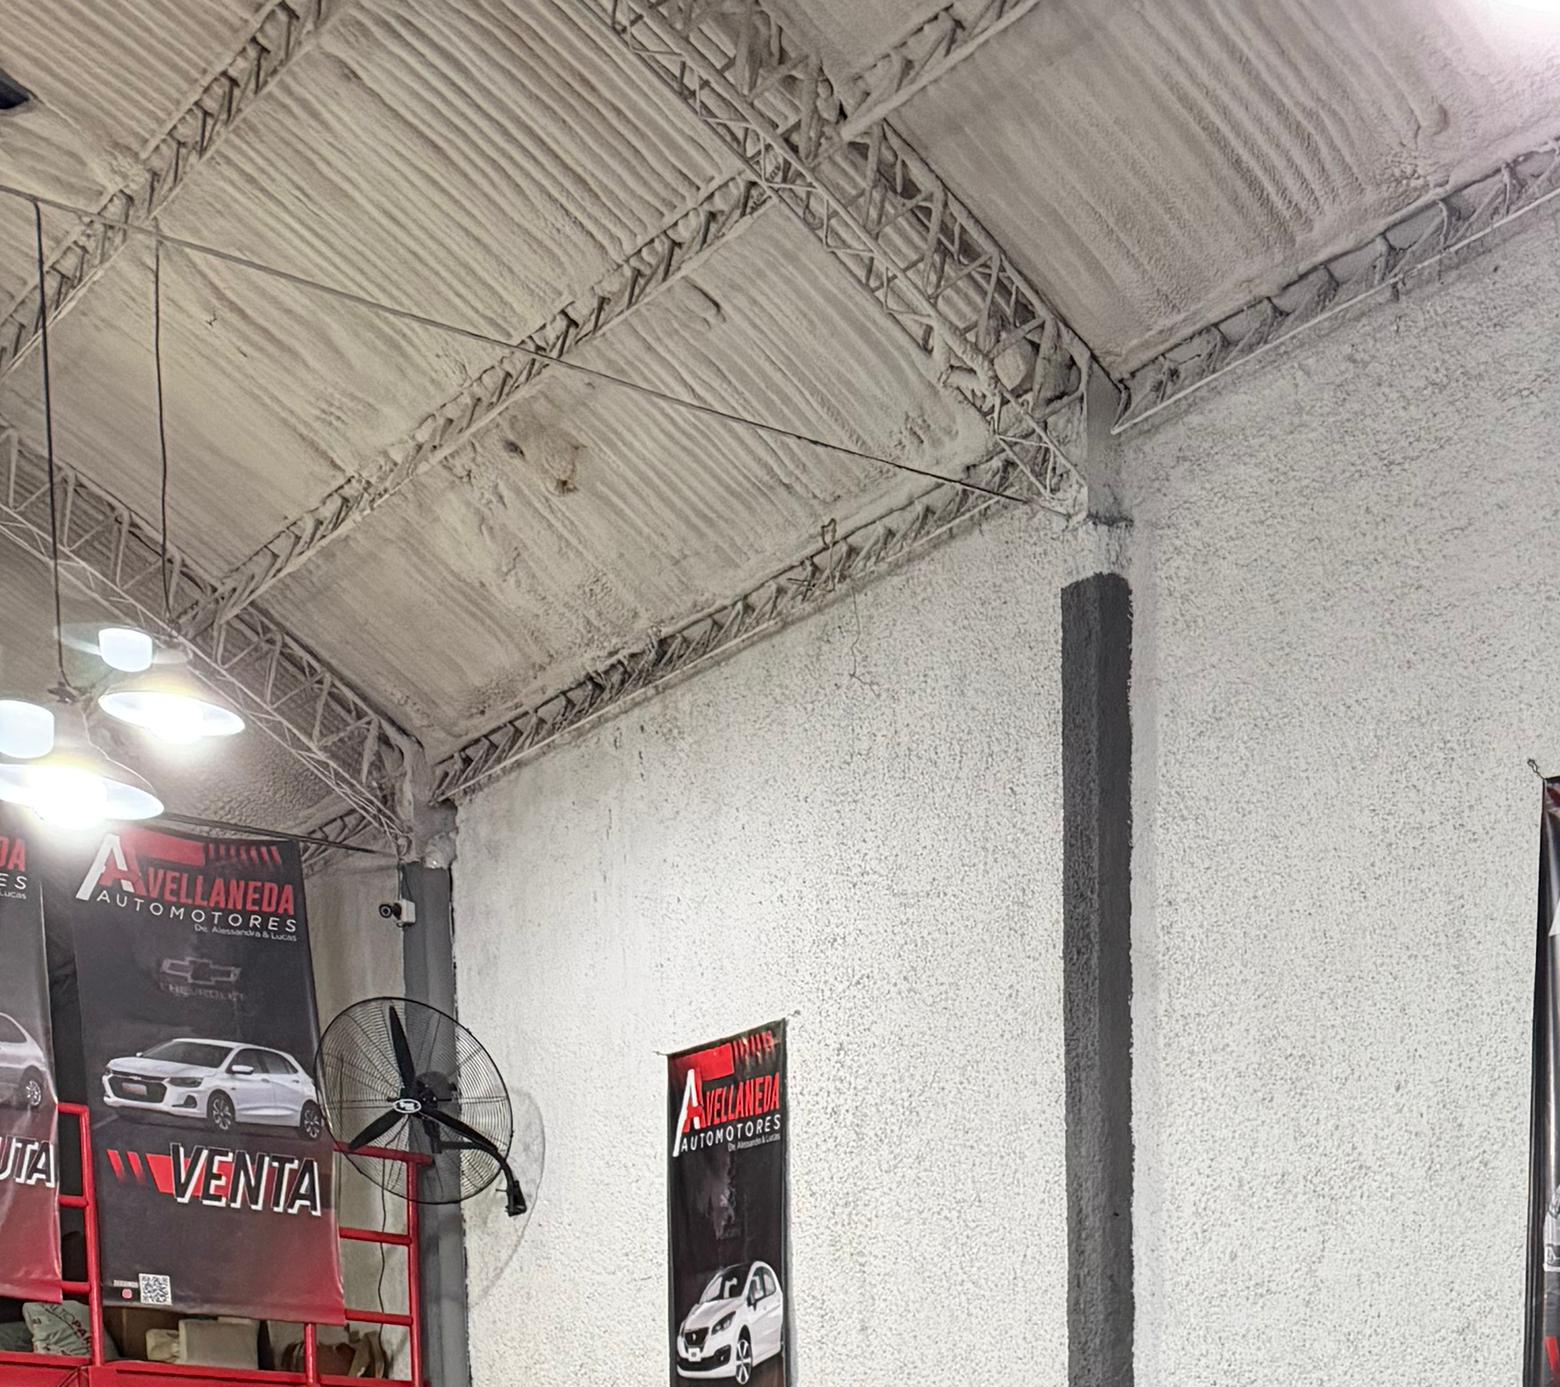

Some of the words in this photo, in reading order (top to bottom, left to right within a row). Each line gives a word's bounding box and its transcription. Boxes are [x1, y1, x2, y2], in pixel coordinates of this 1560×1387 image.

[76, 832, 295, 915] AVELLANEDA
[97, 890, 297, 932] AUTOMOTORES
[672, 1069, 780, 1157] AVELLANEDA
[681, 1114, 781, 1152] AUTOMOTORES
[170, 1142, 321, 1216] VENTA
